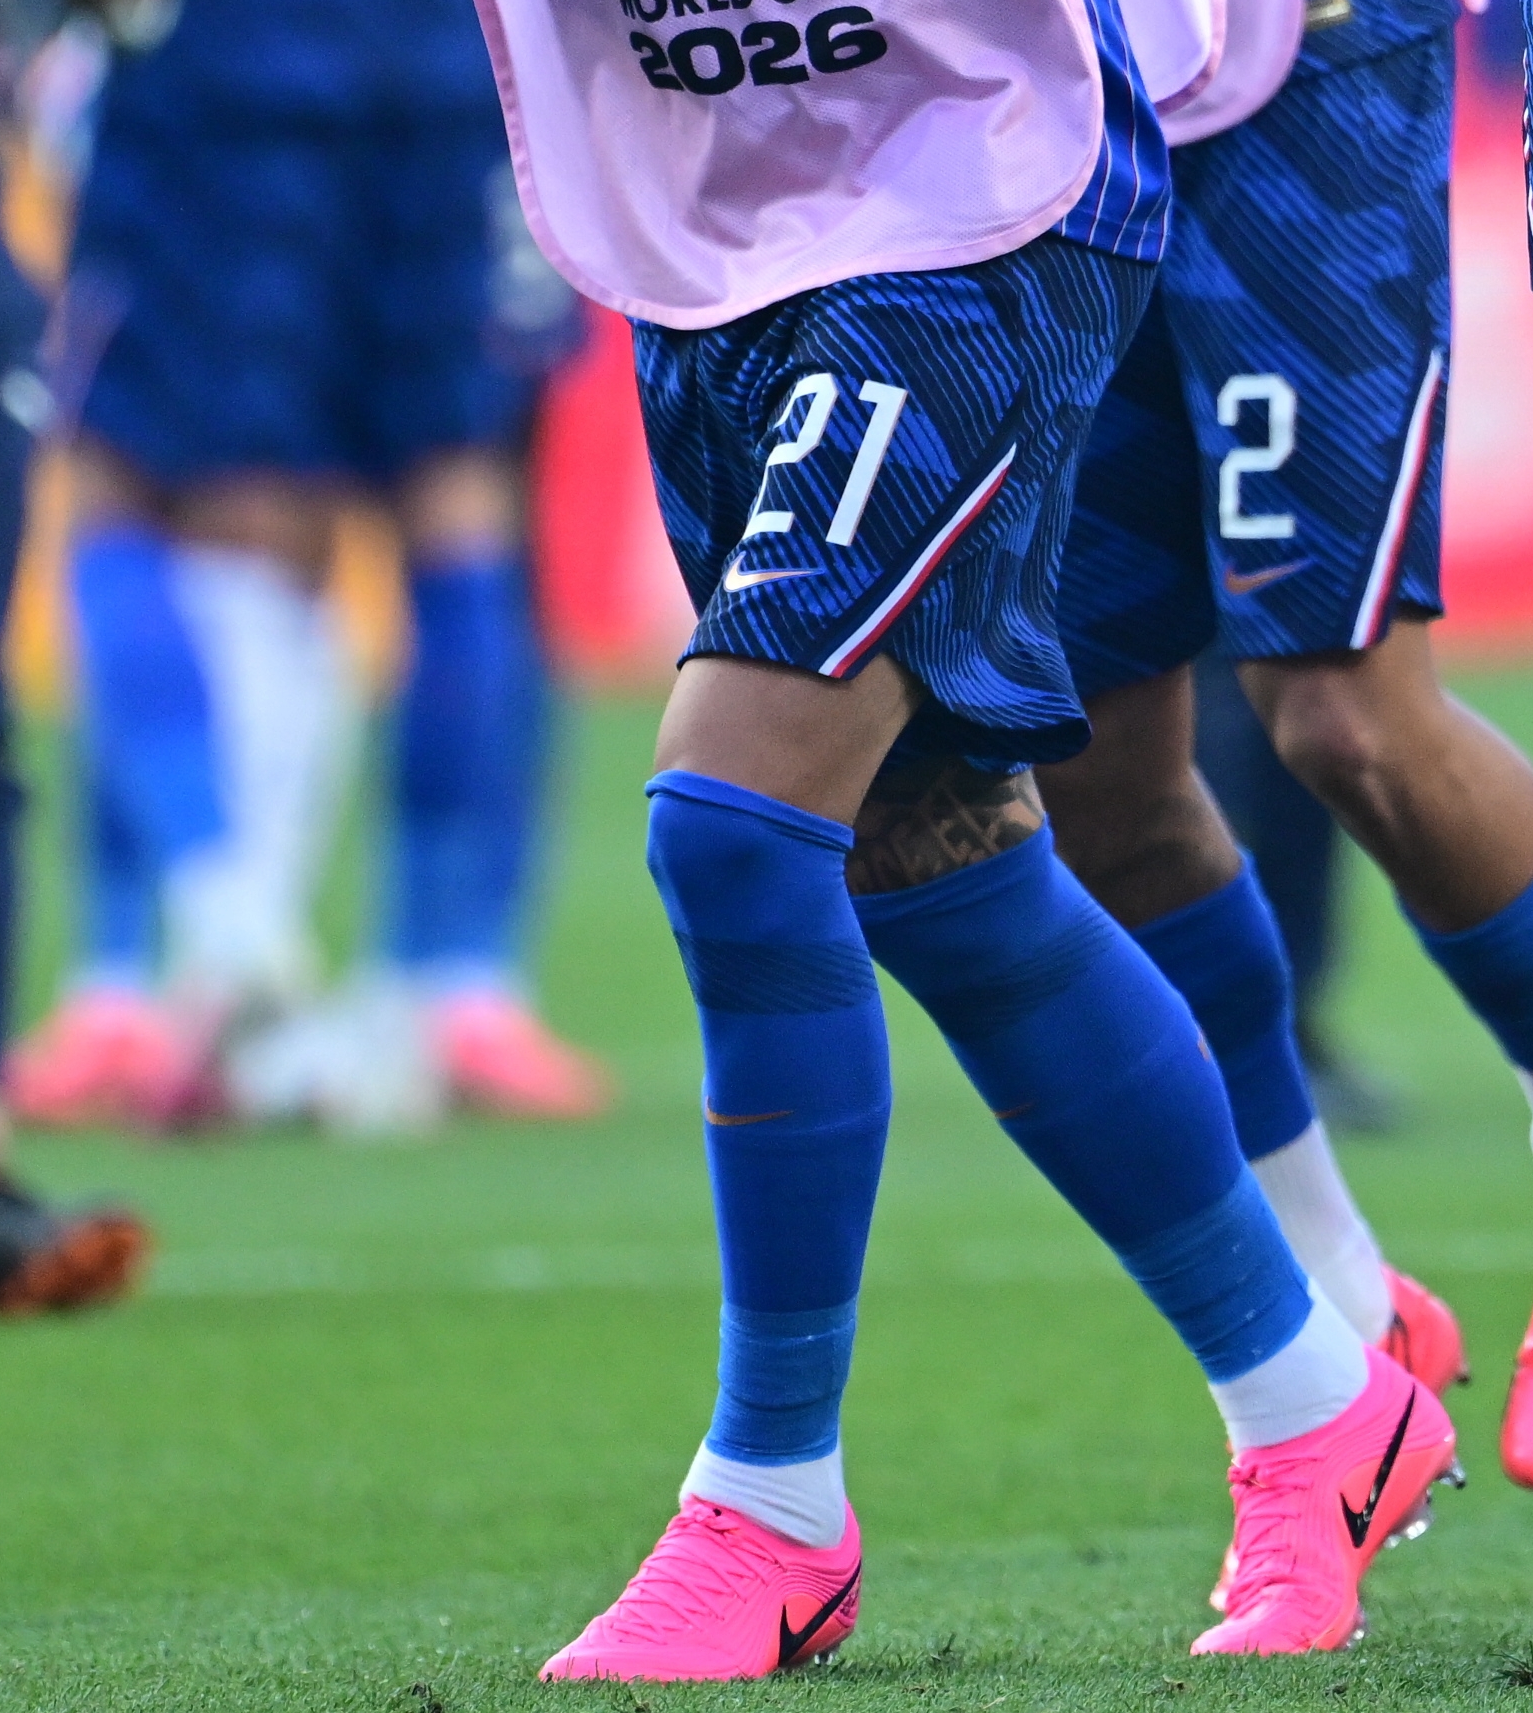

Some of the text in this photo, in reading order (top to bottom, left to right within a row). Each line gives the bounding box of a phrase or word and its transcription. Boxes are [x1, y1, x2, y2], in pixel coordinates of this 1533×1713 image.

[629, 5, 887, 96] 2026
[745, 372, 908, 547] 21
[1217, 374, 1298, 540] 2
